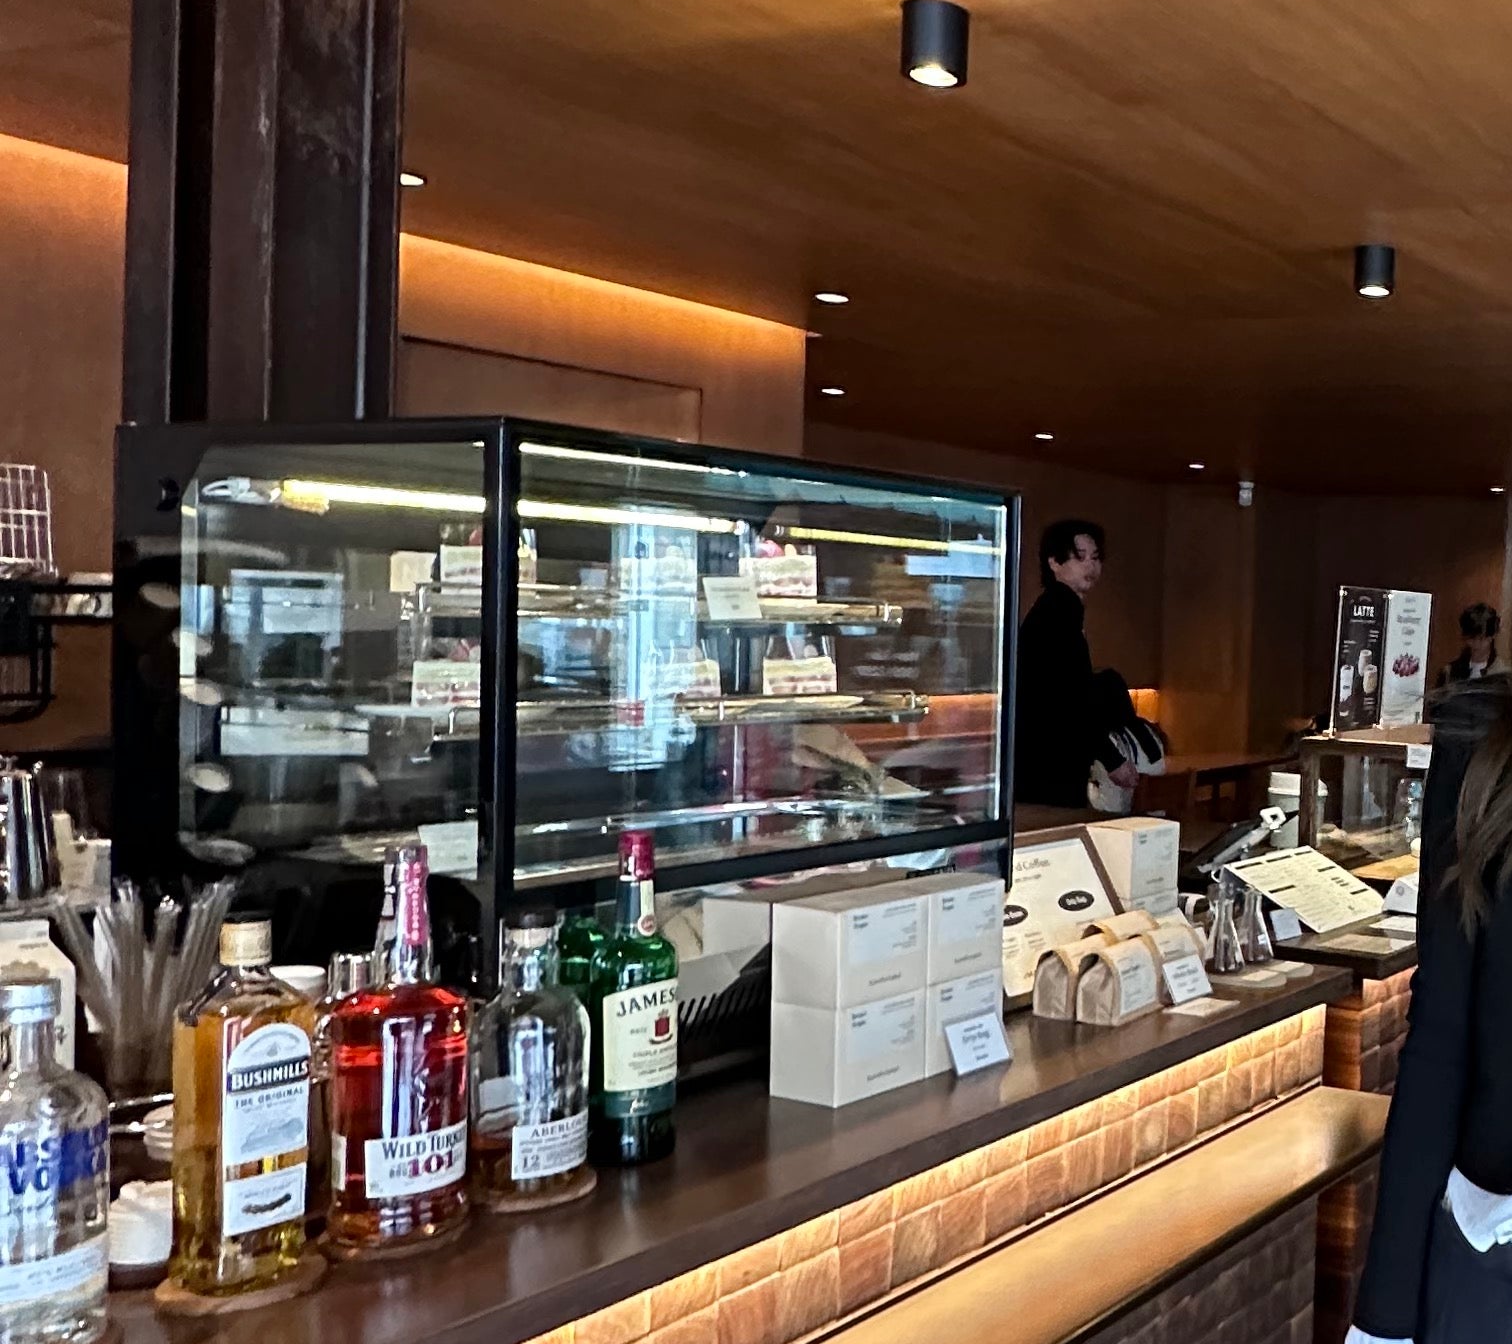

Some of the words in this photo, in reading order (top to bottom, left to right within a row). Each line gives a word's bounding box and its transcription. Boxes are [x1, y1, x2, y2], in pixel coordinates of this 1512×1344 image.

[1353, 605, 1375, 618] LATTE
[231, 1059, 309, 1092] BUSHMILLS
[381, 1140, 427, 1161] WILD
[408, 1150, 454, 1179] 101
